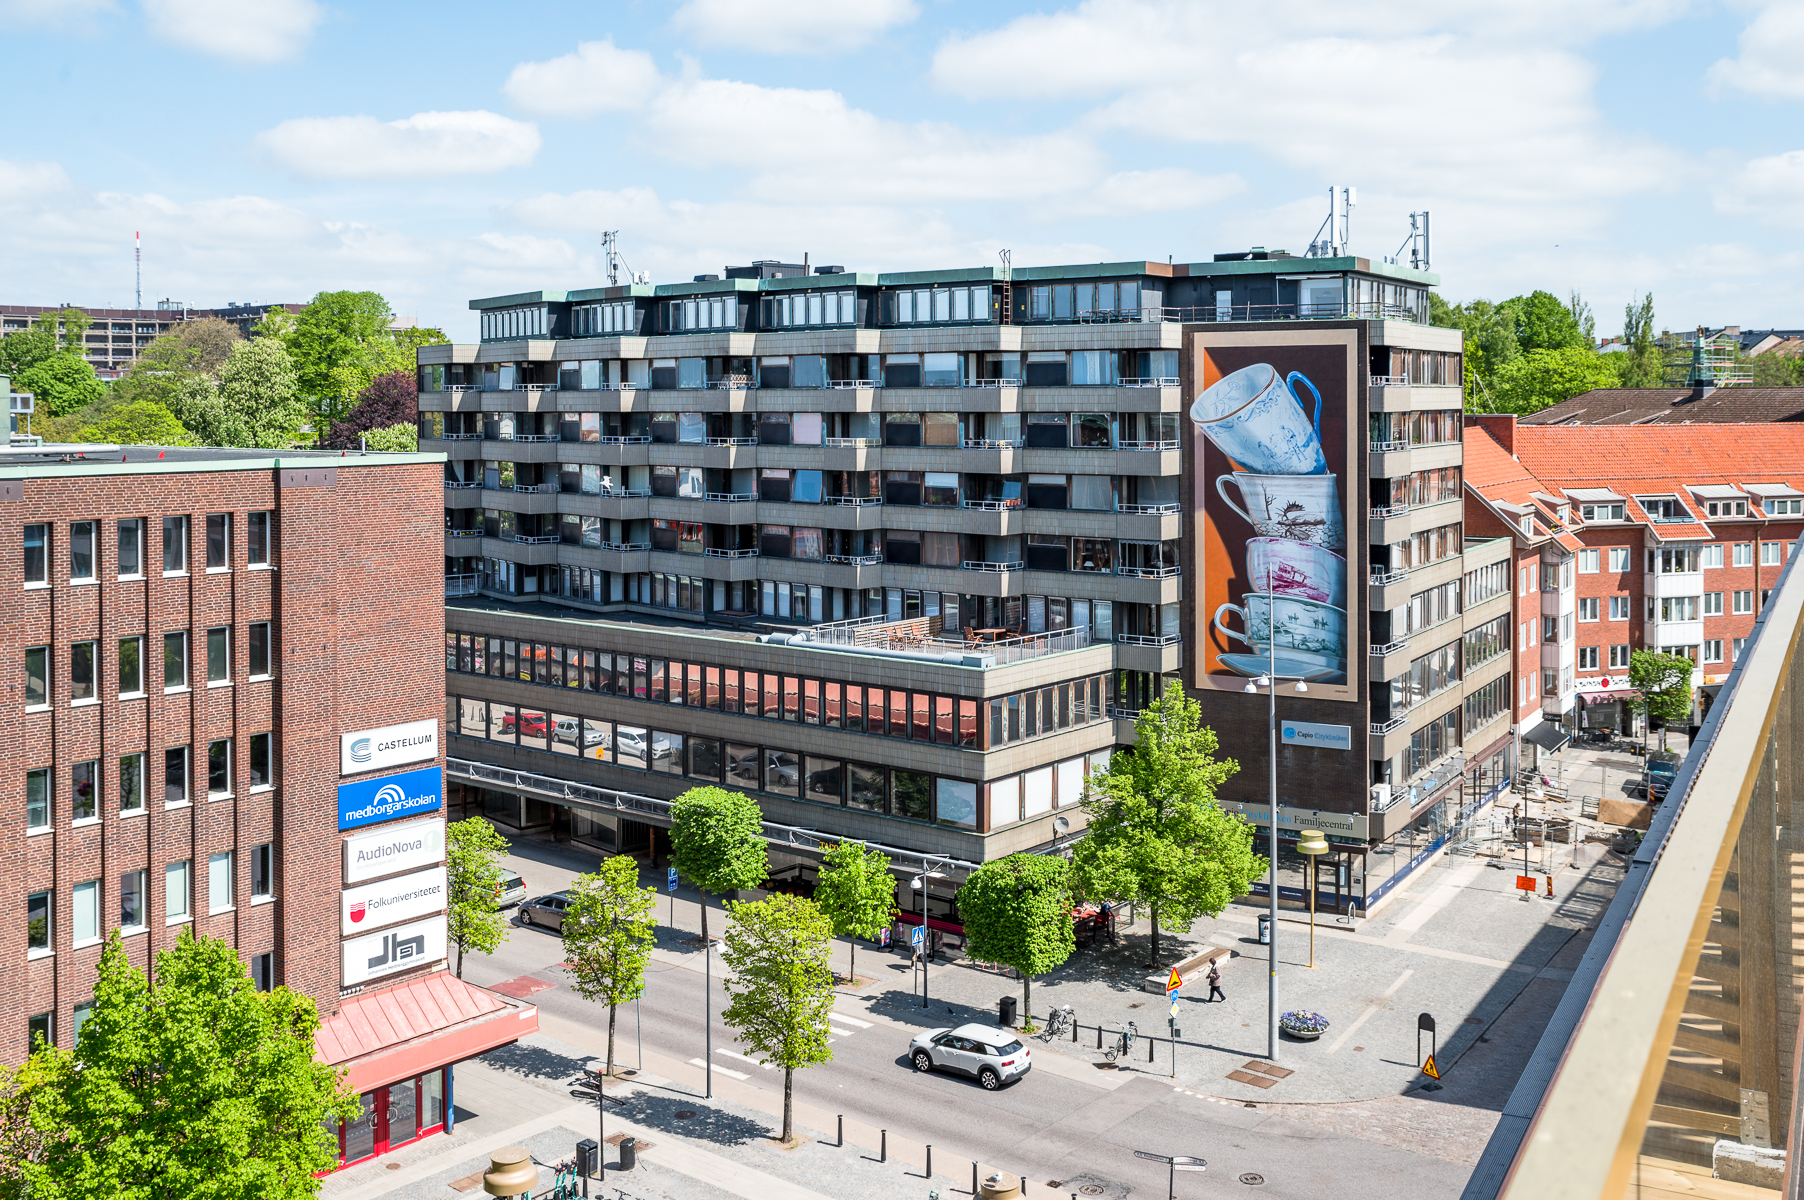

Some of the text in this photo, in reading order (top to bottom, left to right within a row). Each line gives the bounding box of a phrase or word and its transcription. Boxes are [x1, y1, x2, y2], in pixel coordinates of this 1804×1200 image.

[377, 734, 432, 751] CASTELLUM
[1297, 731, 1313, 739] Capio
[345, 794, 436, 821] medborgarskolan
[1241, 809, 1291, 823] Citykliken
[1294, 815, 1353, 831] Familjecentral
[356, 839, 422, 862] AudioNova
[368, 885, 441, 910] Folkuniversitetet
